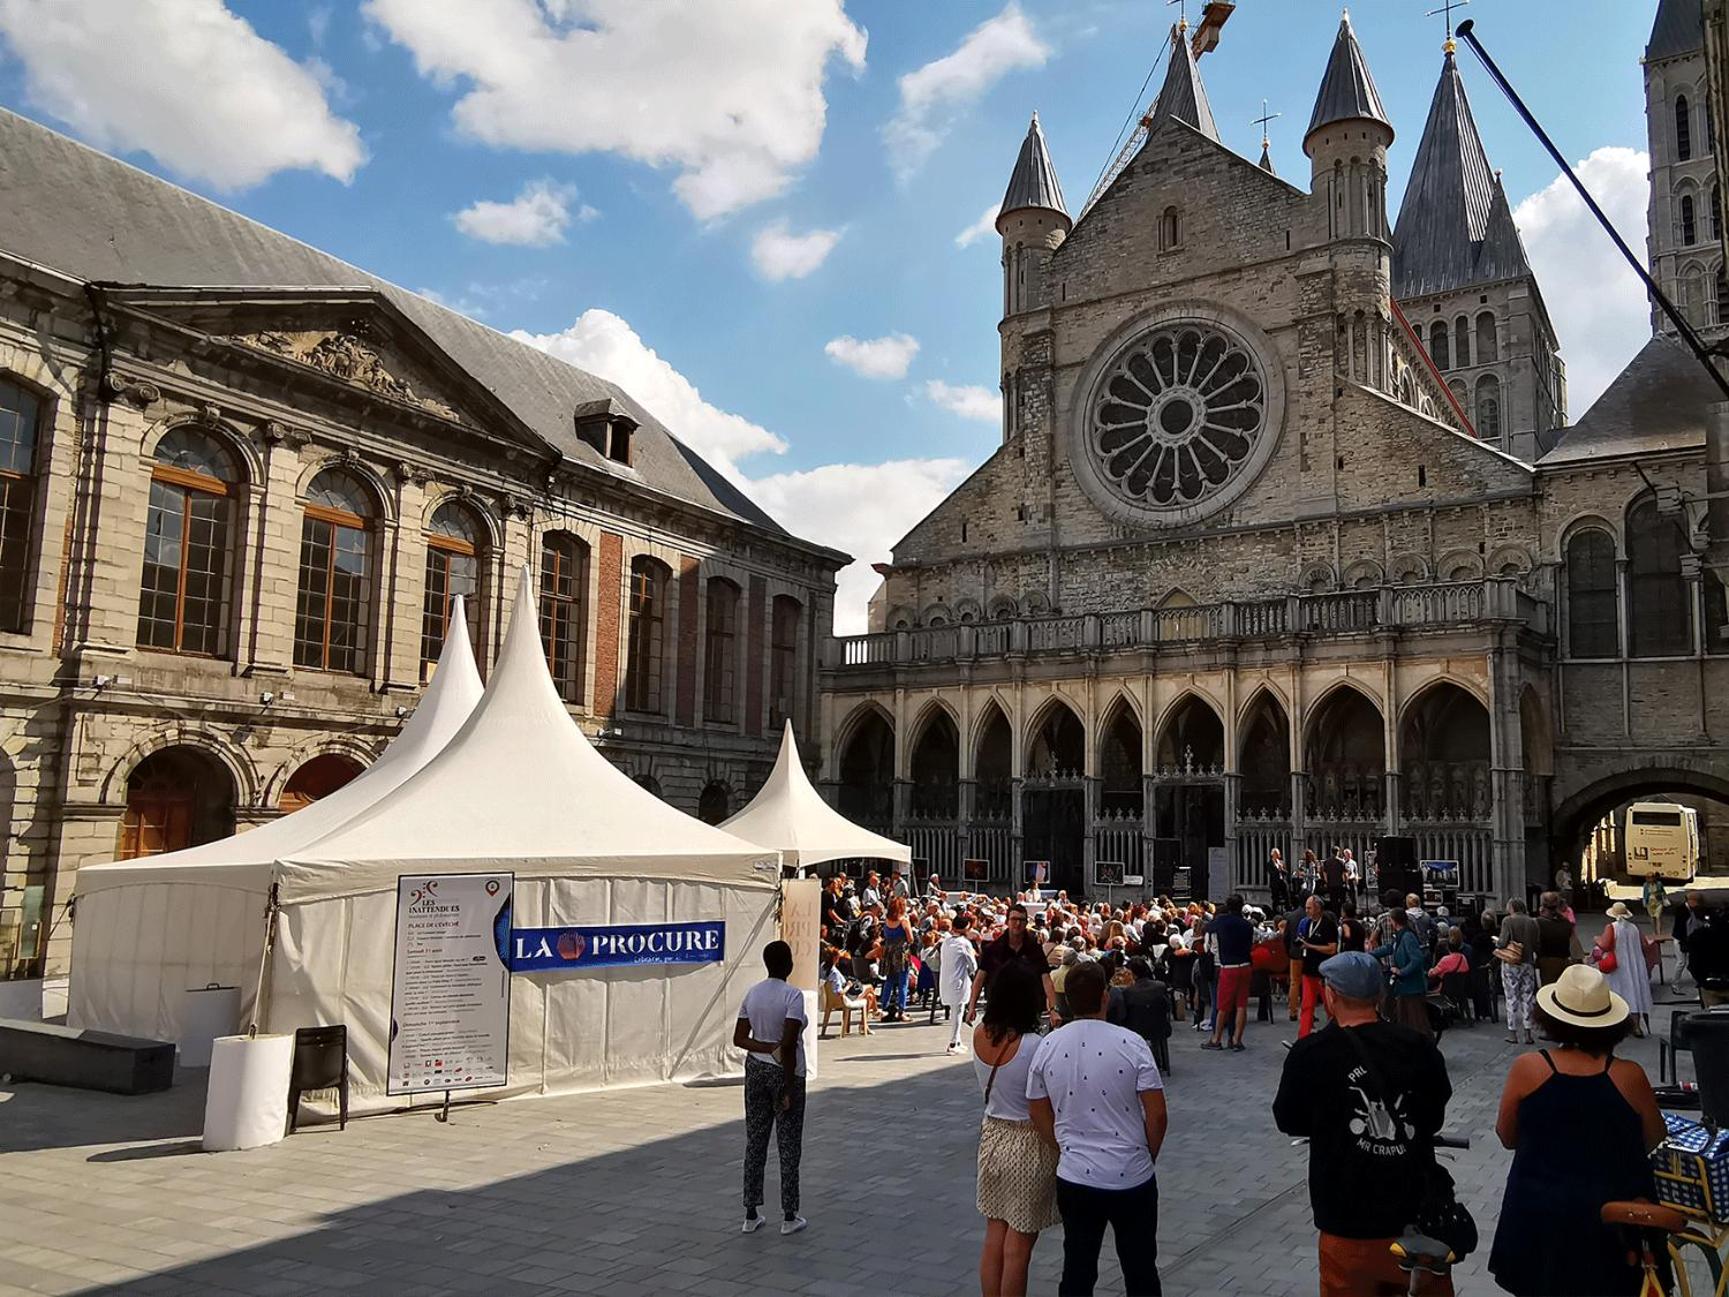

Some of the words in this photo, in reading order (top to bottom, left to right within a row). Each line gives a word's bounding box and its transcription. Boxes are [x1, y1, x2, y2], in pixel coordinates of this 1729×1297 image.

[408, 905, 461, 913] INATTENDUES
[515, 936, 554, 959] LA
[592, 929, 719, 956] PROCURE
[1356, 1137, 1372, 1152] MR
[1372, 1144, 1407, 1156] CRAPU
